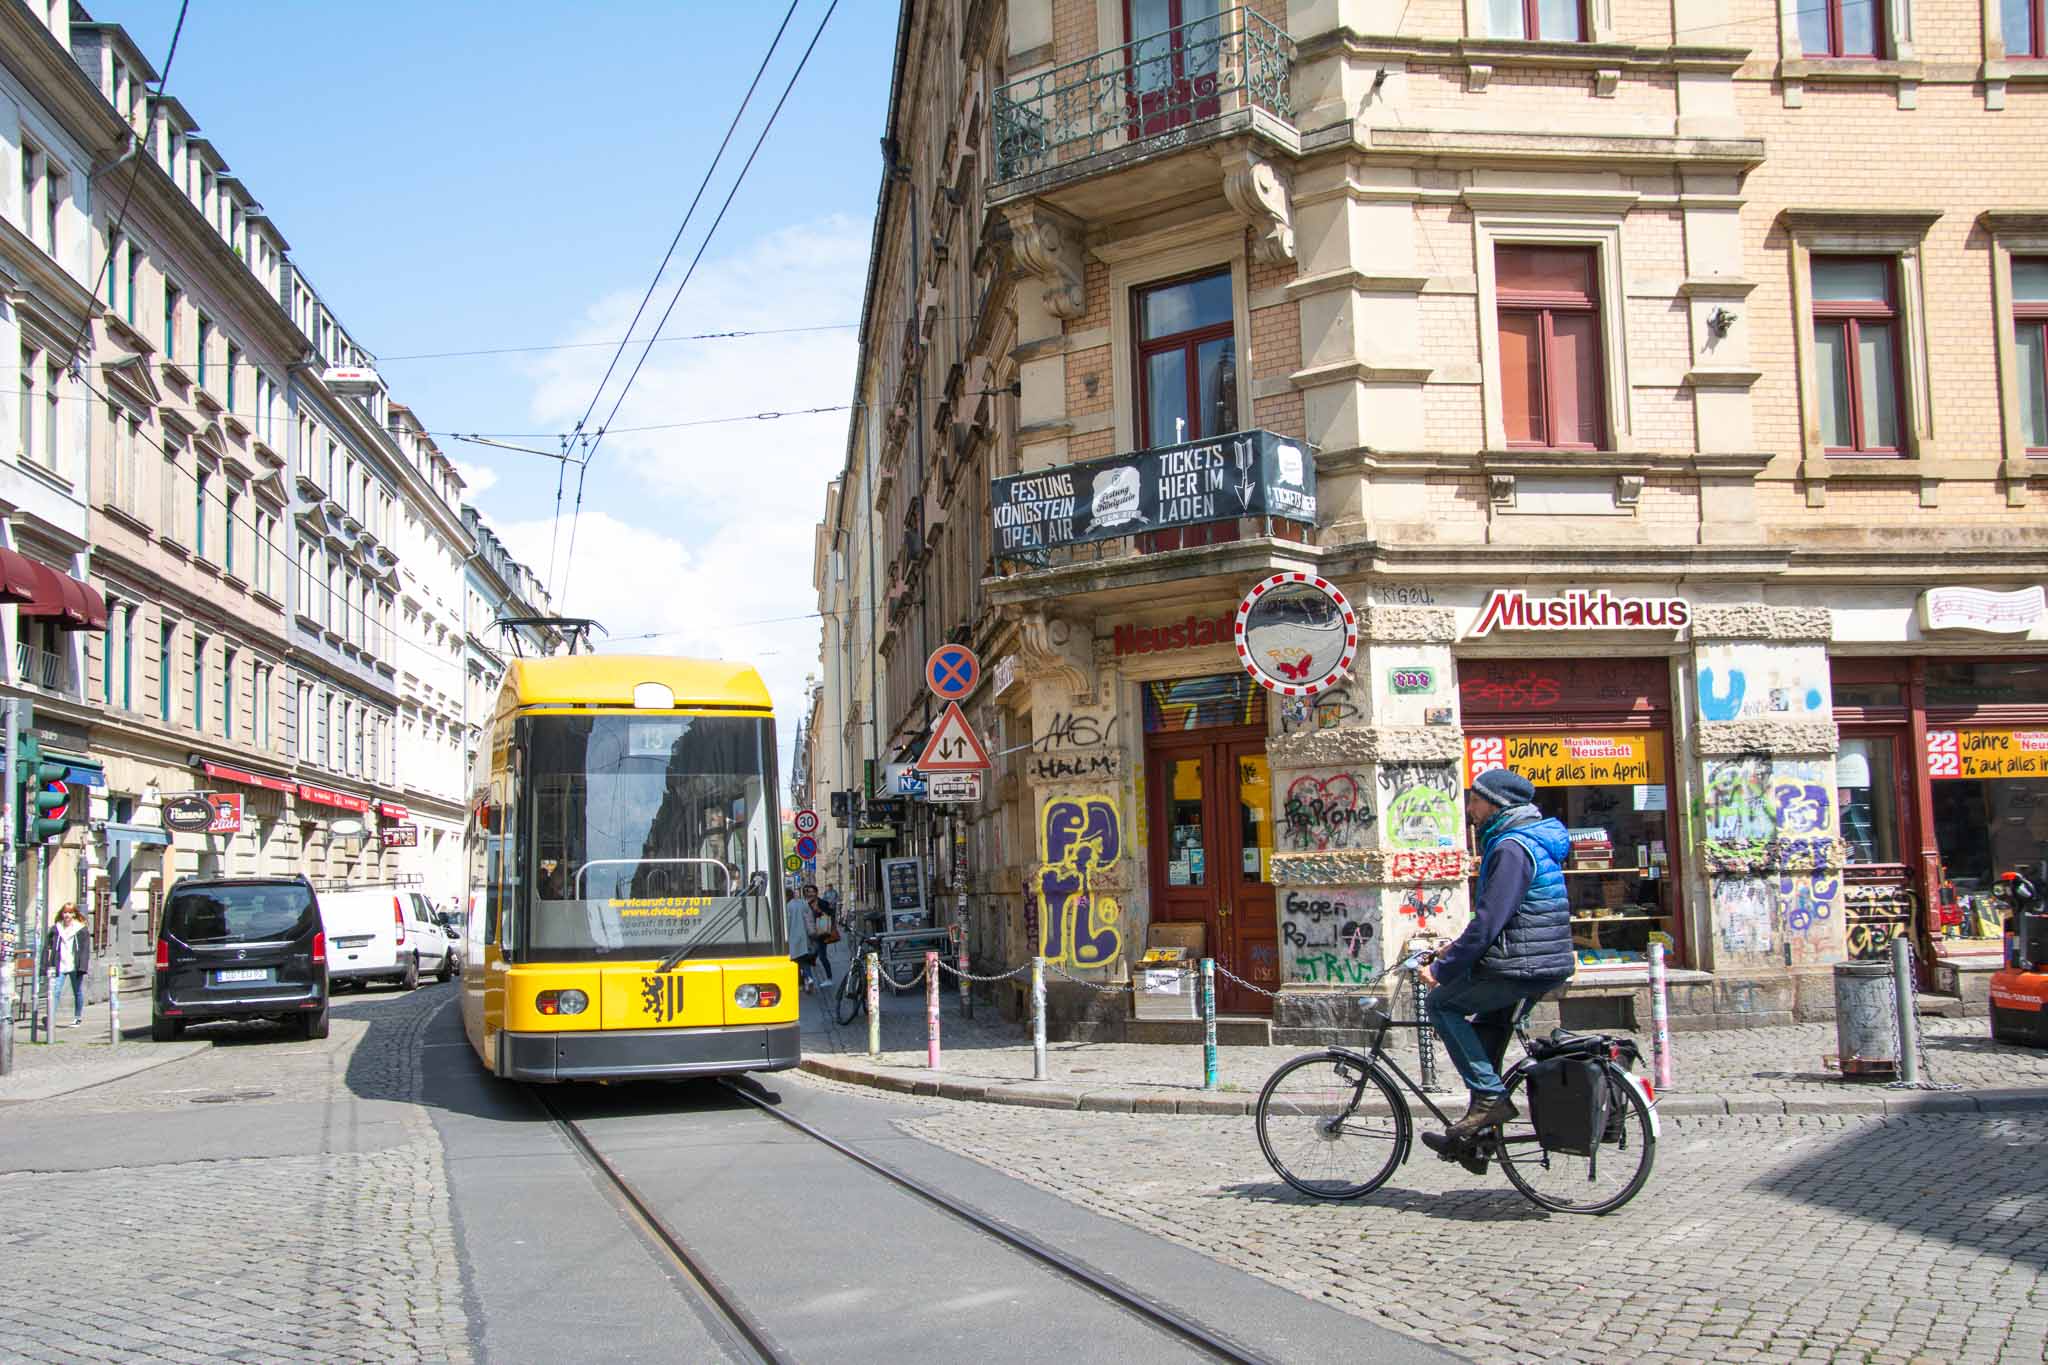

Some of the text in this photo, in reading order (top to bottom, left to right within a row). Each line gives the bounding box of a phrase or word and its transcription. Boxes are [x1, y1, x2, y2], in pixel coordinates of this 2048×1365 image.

[1159, 444, 1225, 476] TICKETS
[1010, 473, 1075, 502] FESTUNG
[1158, 468, 1224, 501] HIER IM
[993, 496, 1076, 529] KÖNIGSTEIN
[1159, 494, 1215, 524] LADEN
[1002, 517, 1075, 550] OPEN AIR
[1477, 593, 1688, 633] Musikhaus
[1113, 610, 1236, 657] Neustad
[1470, 736, 1613, 761] 22 Jahre Musikhaus
[1571, 745, 1630, 757] Neustadt
[1926, 730, 1957, 752] 22
[1962, 731, 2009, 752] Jahre
[1527, 764, 1552, 784] auf
[1555, 763, 1586, 781] alles
[1589, 762, 1609, 780] im
[1612, 761, 1650, 783] April!
[1927, 753, 1959, 775] 22
[2007, 756, 2036, 773] alles
[799, 816, 814, 828] 30
[1286, 891, 1348, 923] Gegen
